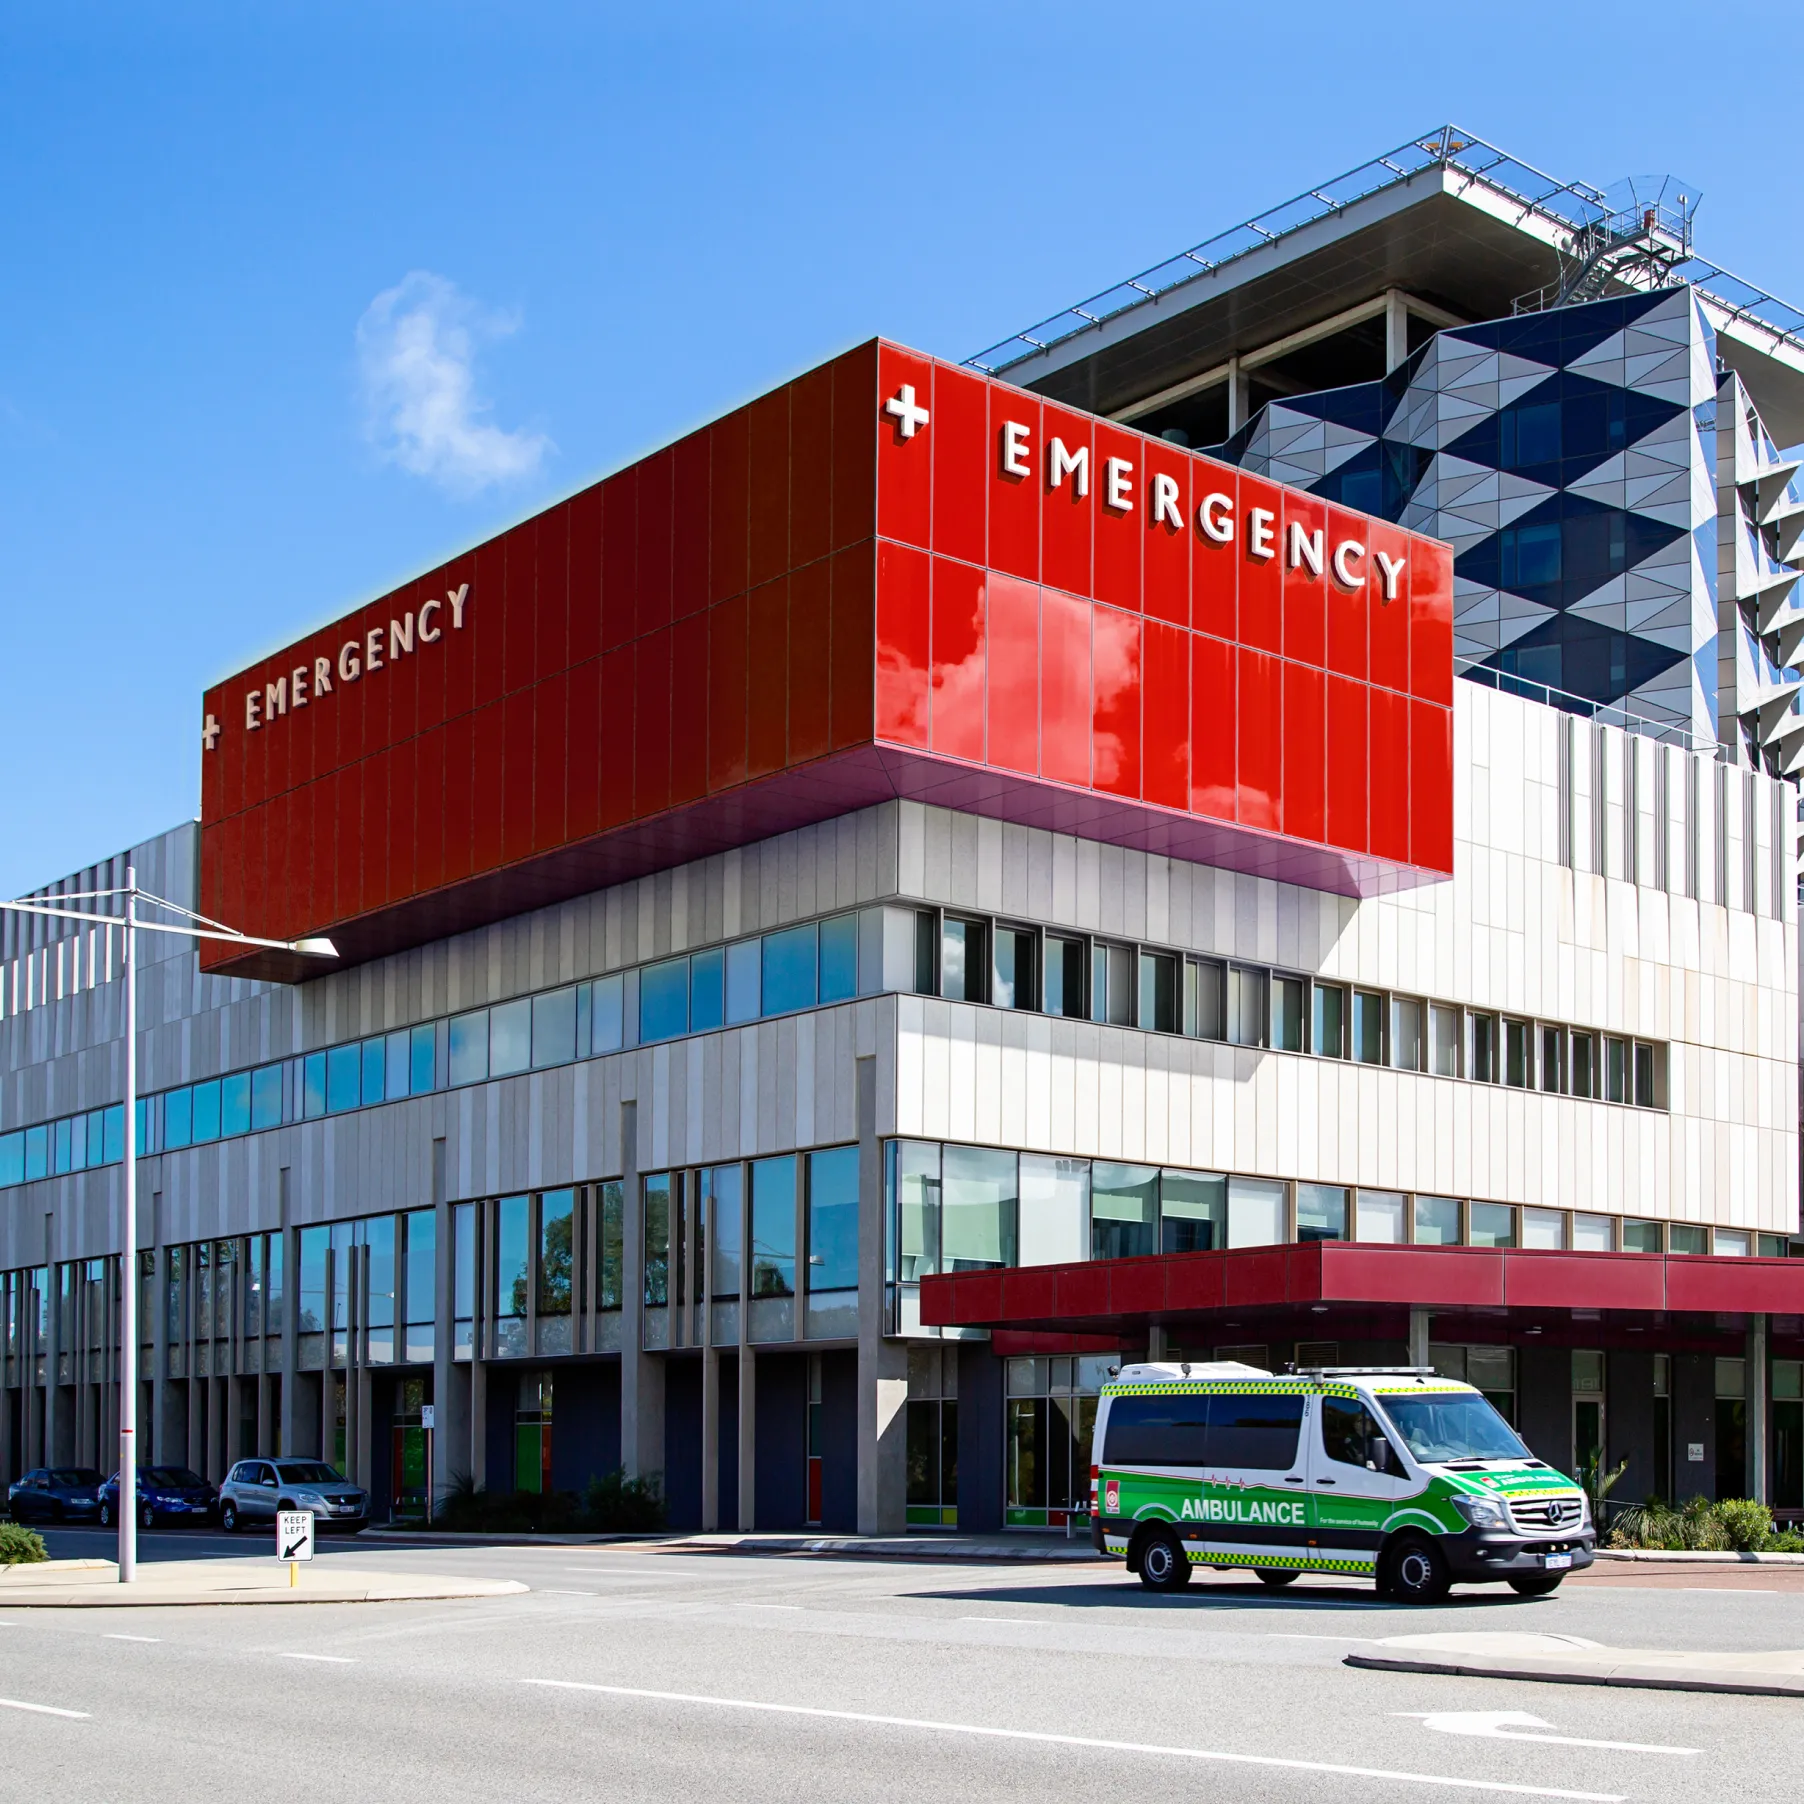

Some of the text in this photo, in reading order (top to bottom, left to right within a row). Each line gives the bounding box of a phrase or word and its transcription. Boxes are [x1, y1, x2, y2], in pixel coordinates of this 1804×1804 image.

[1003, 420, 1407, 600] EMERGENCY
[245, 583, 470, 730] EMERGENCY
[283, 1515, 307, 1525] KEEP
[1180, 1498, 1306, 1525] AMBULANCE
[284, 1525, 306, 1535] LEFT
